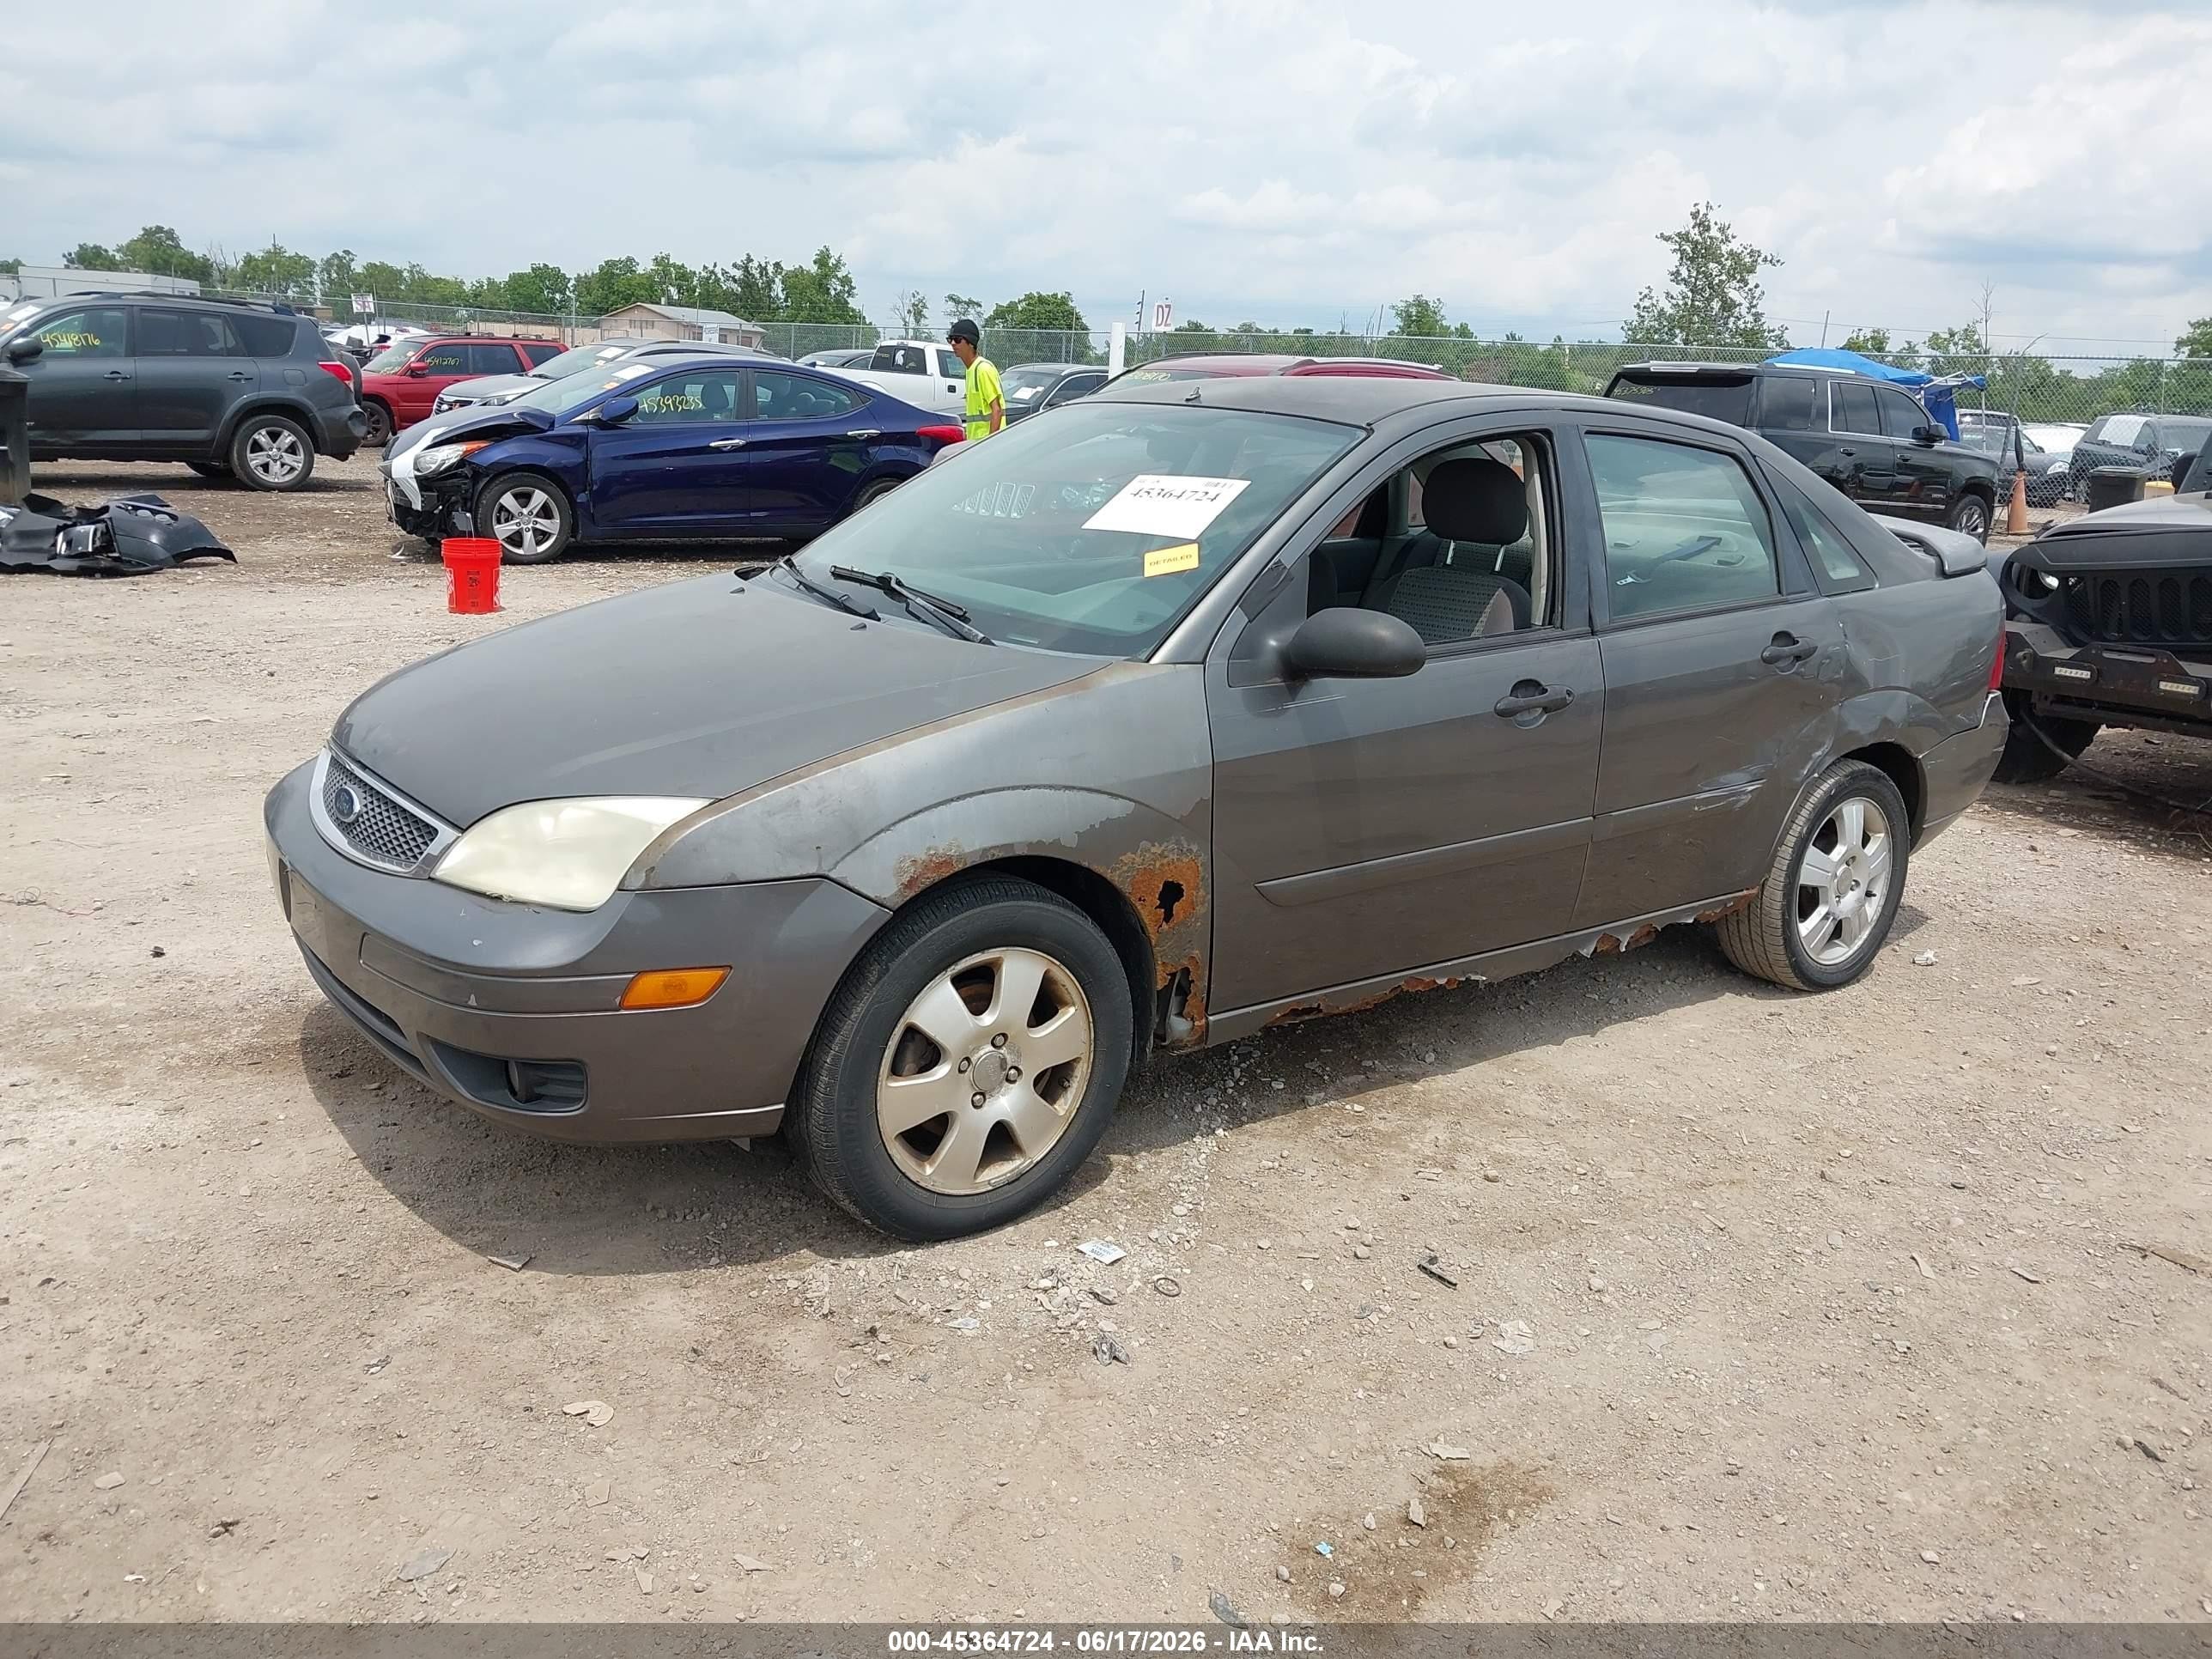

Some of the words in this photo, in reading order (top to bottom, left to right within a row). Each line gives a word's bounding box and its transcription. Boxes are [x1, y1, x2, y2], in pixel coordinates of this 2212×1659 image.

[40, 332, 101, 349] 45418176
[1129, 487, 1222, 502] 45364724
[1149, 554, 1194, 568] DETAILED
